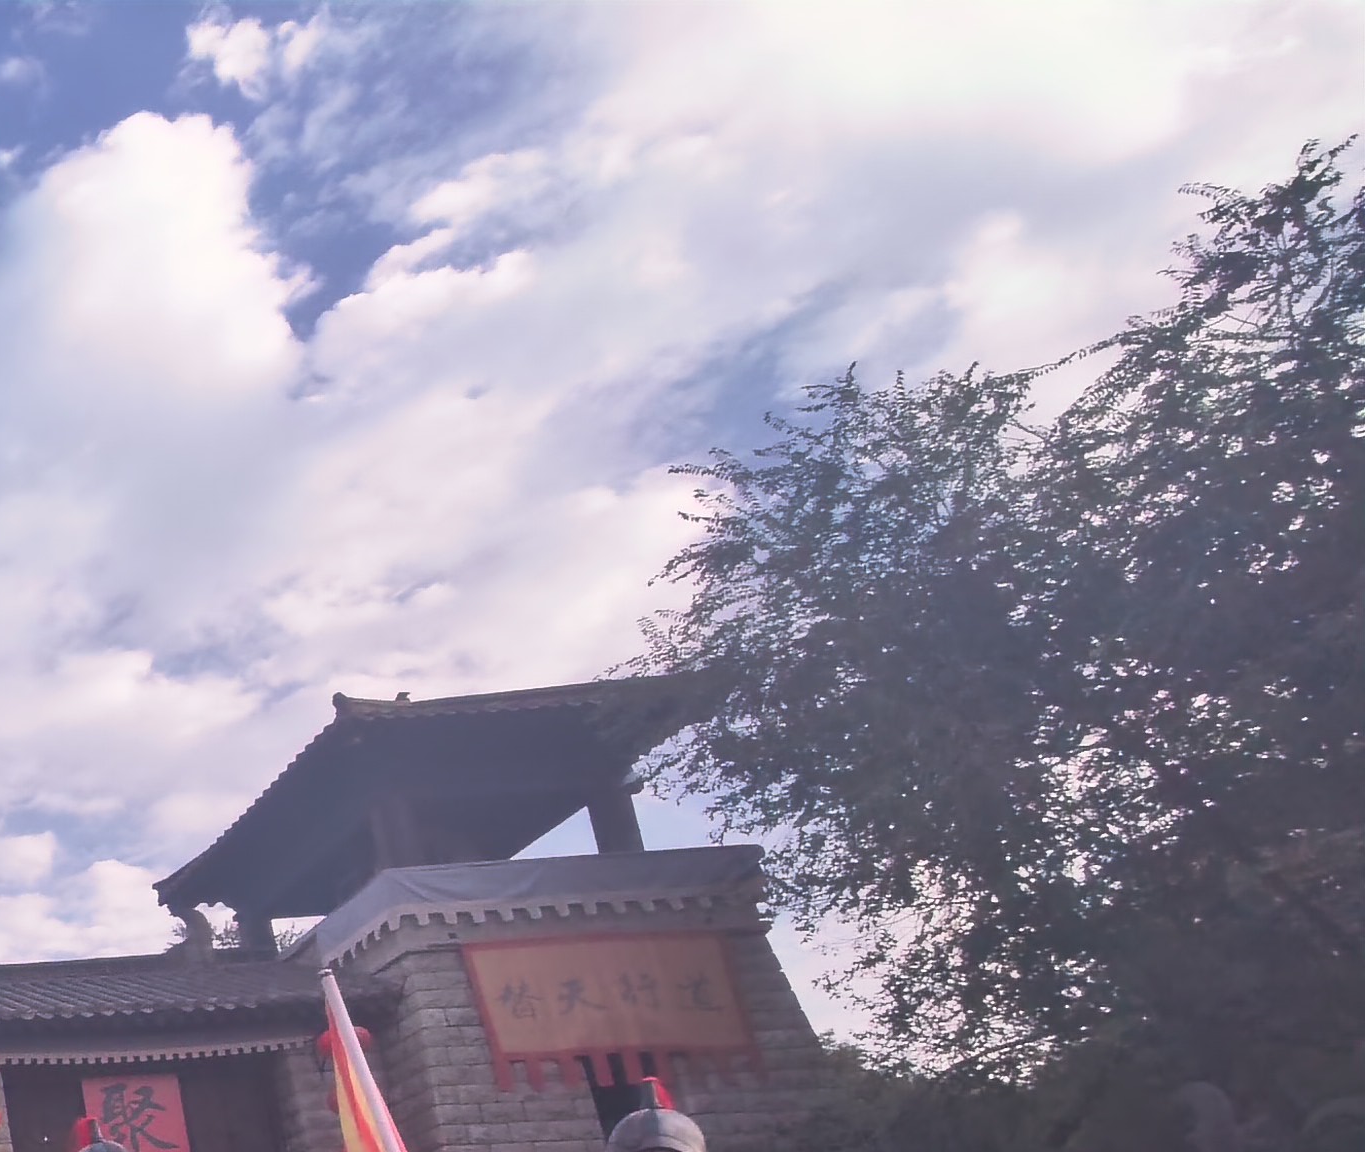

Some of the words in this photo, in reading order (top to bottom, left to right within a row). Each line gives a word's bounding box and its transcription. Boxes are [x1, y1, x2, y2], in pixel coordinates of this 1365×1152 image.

[495, 970, 725, 1020] 替天行道
[101, 1083, 180, 1152] 聚
